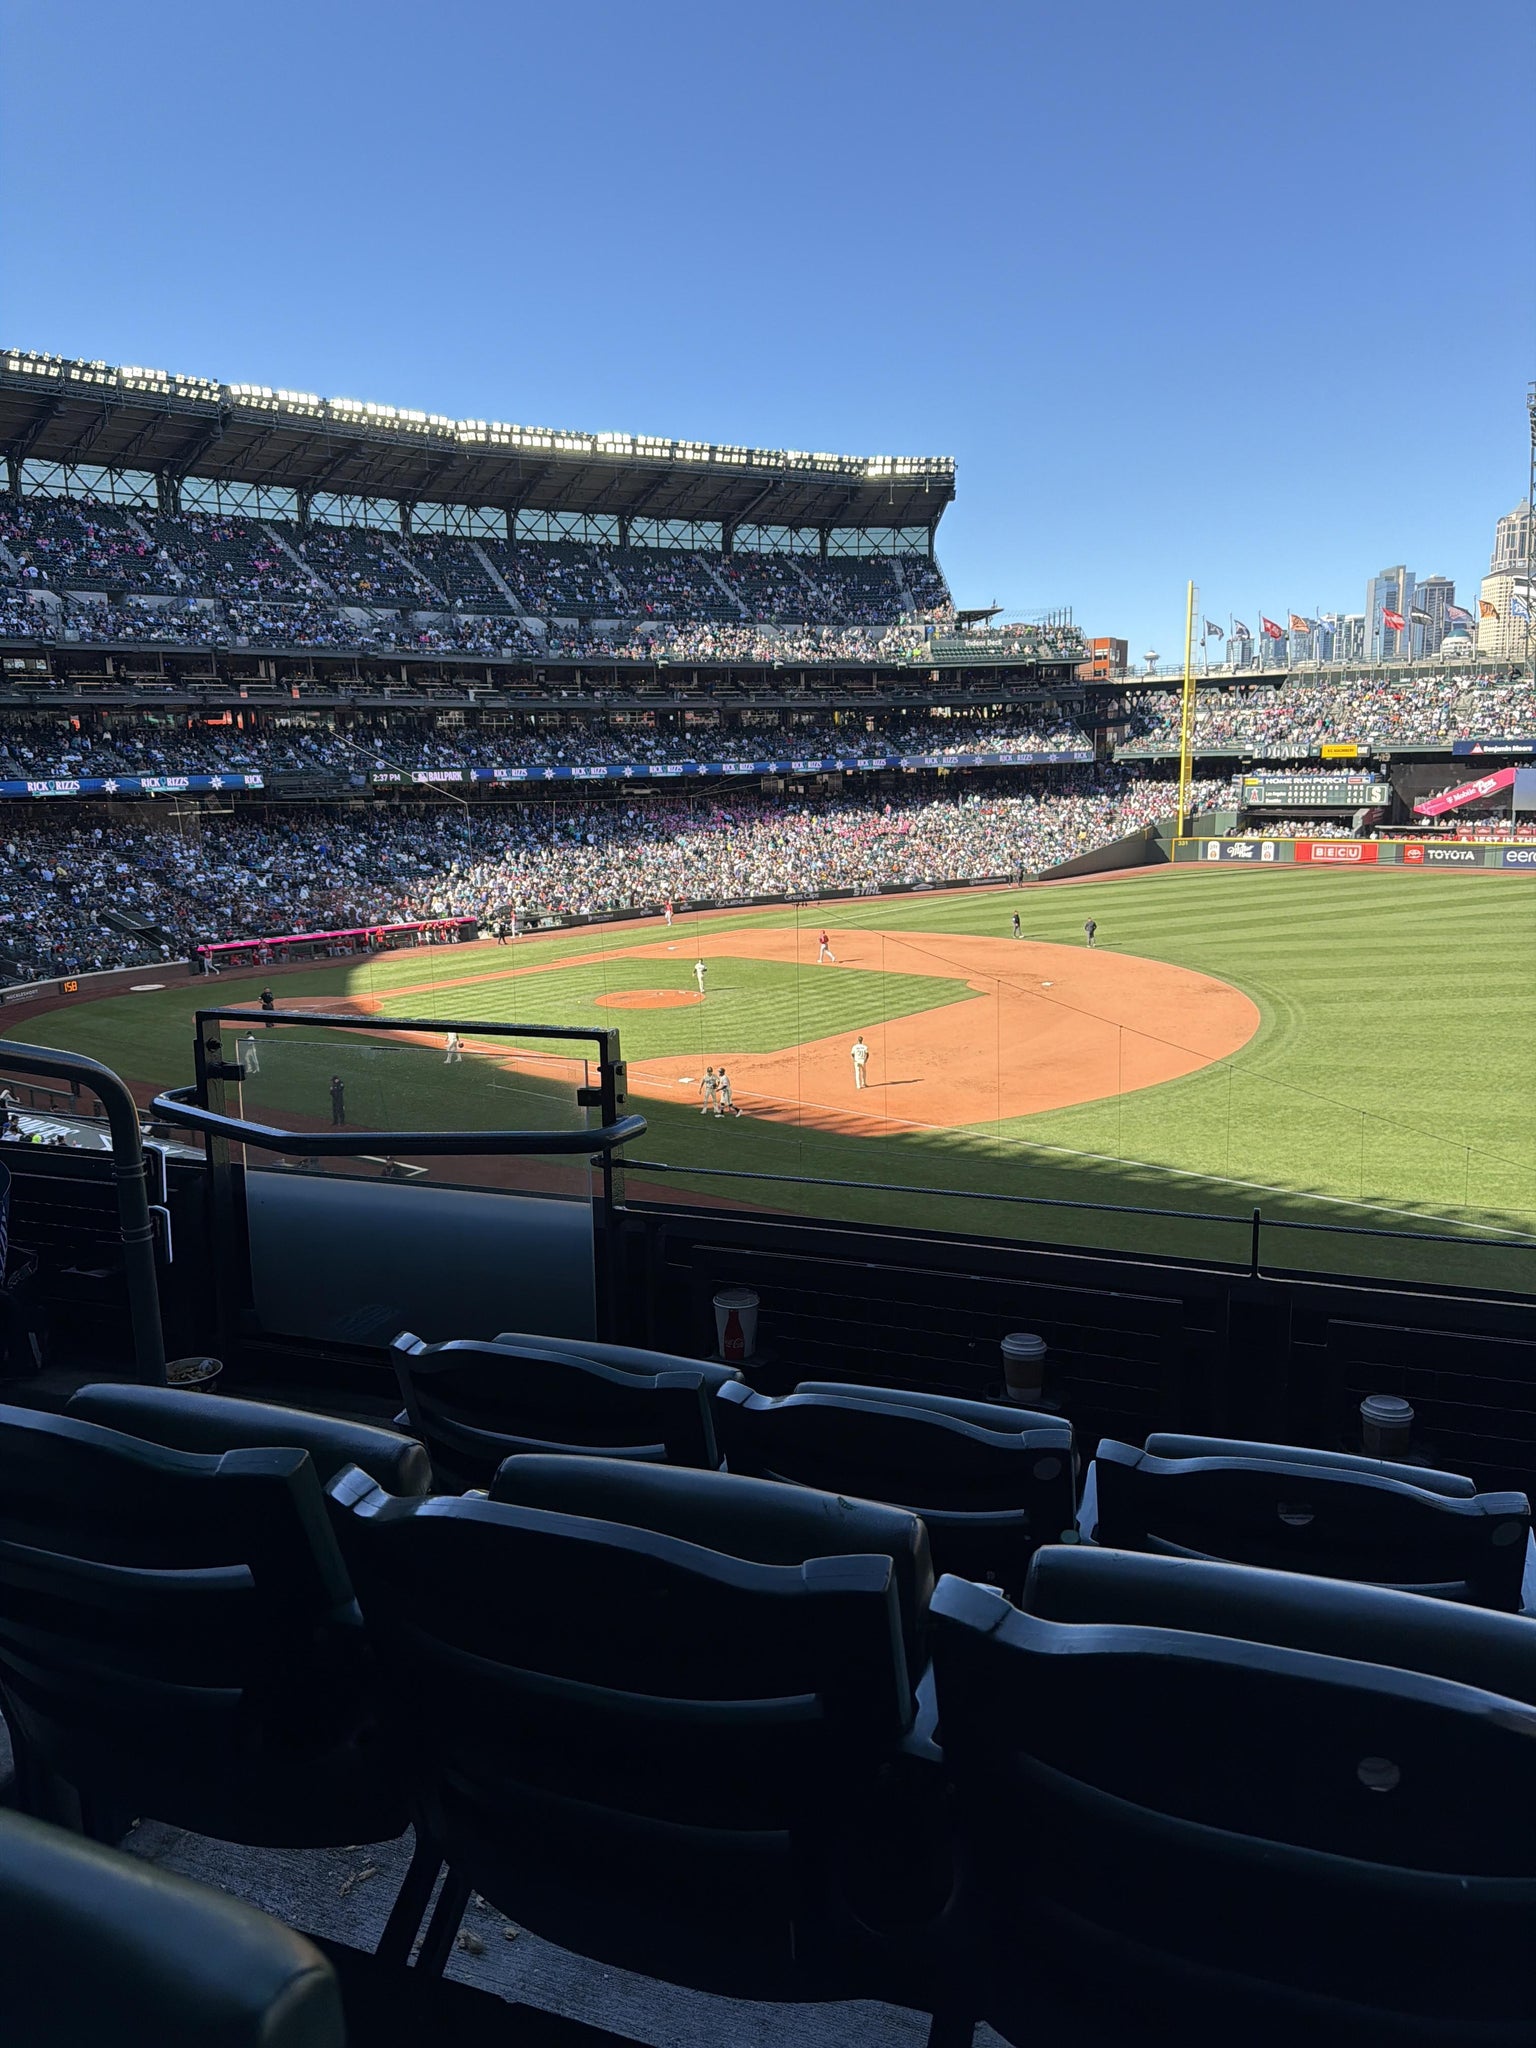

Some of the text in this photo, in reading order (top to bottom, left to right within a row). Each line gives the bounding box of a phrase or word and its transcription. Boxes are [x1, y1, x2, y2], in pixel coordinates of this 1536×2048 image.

[141, 776, 189, 788] RICK RIZZS
[244, 775, 262, 784] RICK
[372, 774, 400, 782] 2:37 PM
[428, 772, 464, 782] BALLPARK
[27, 780, 80, 792] RICK RIZZS
[1371, 786, 1381, 802] S
[1453, 788, 1476, 802] Mobile
[1316, 848, 1358, 858] BECU
[1428, 850, 1475, 860] TOYOTA
[853, 886, 882, 896] STIHL
